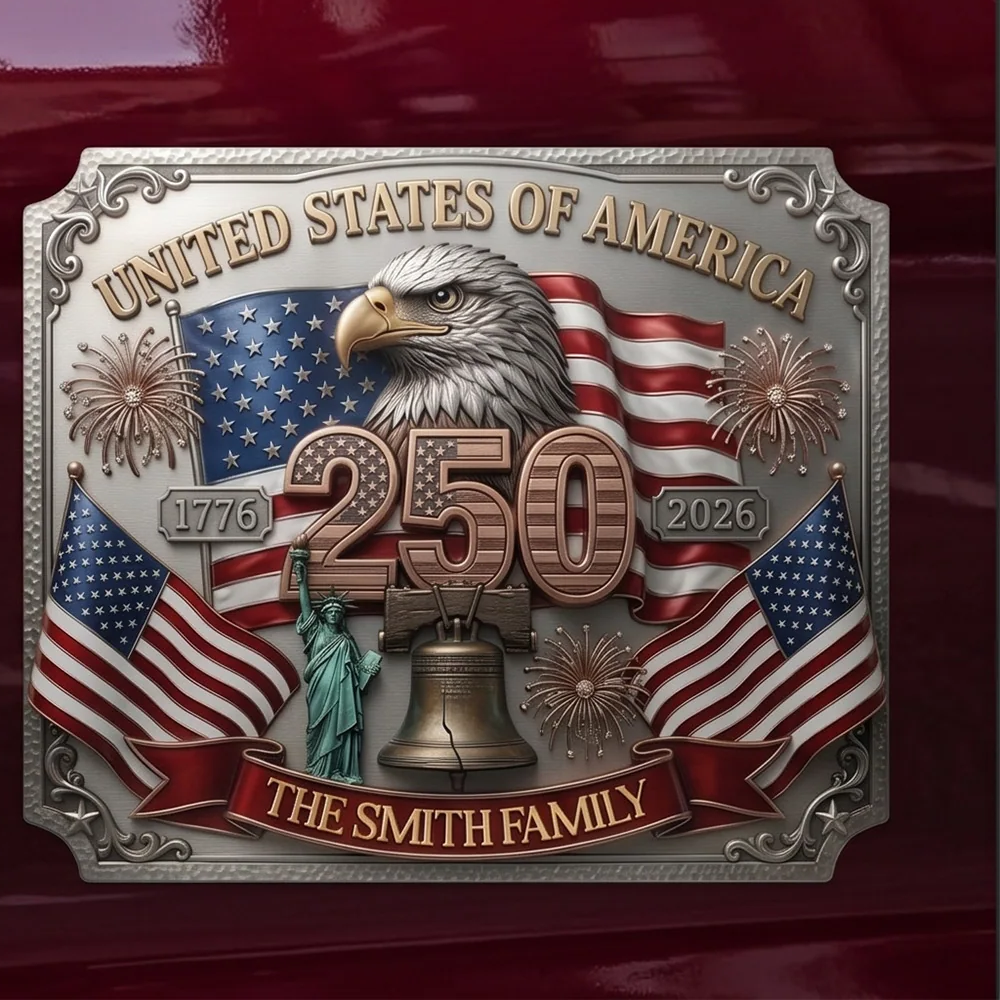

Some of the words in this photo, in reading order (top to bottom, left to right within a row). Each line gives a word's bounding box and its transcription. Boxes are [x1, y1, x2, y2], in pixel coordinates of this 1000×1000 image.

[92, 204, 292, 320] UNITED
[303, 178, 494, 244] STATES
[508, 181, 579, 236] OF
[581, 194, 816, 322] AMERICA
[174, 497, 259, 532] 1776
[279, 425, 636, 606] 250
[666, 497, 757, 532] 2026
[266, 776, 348, 836] THE
[352, 800, 495, 848] SMITH
[499, 778, 648, 846] FAMILY
